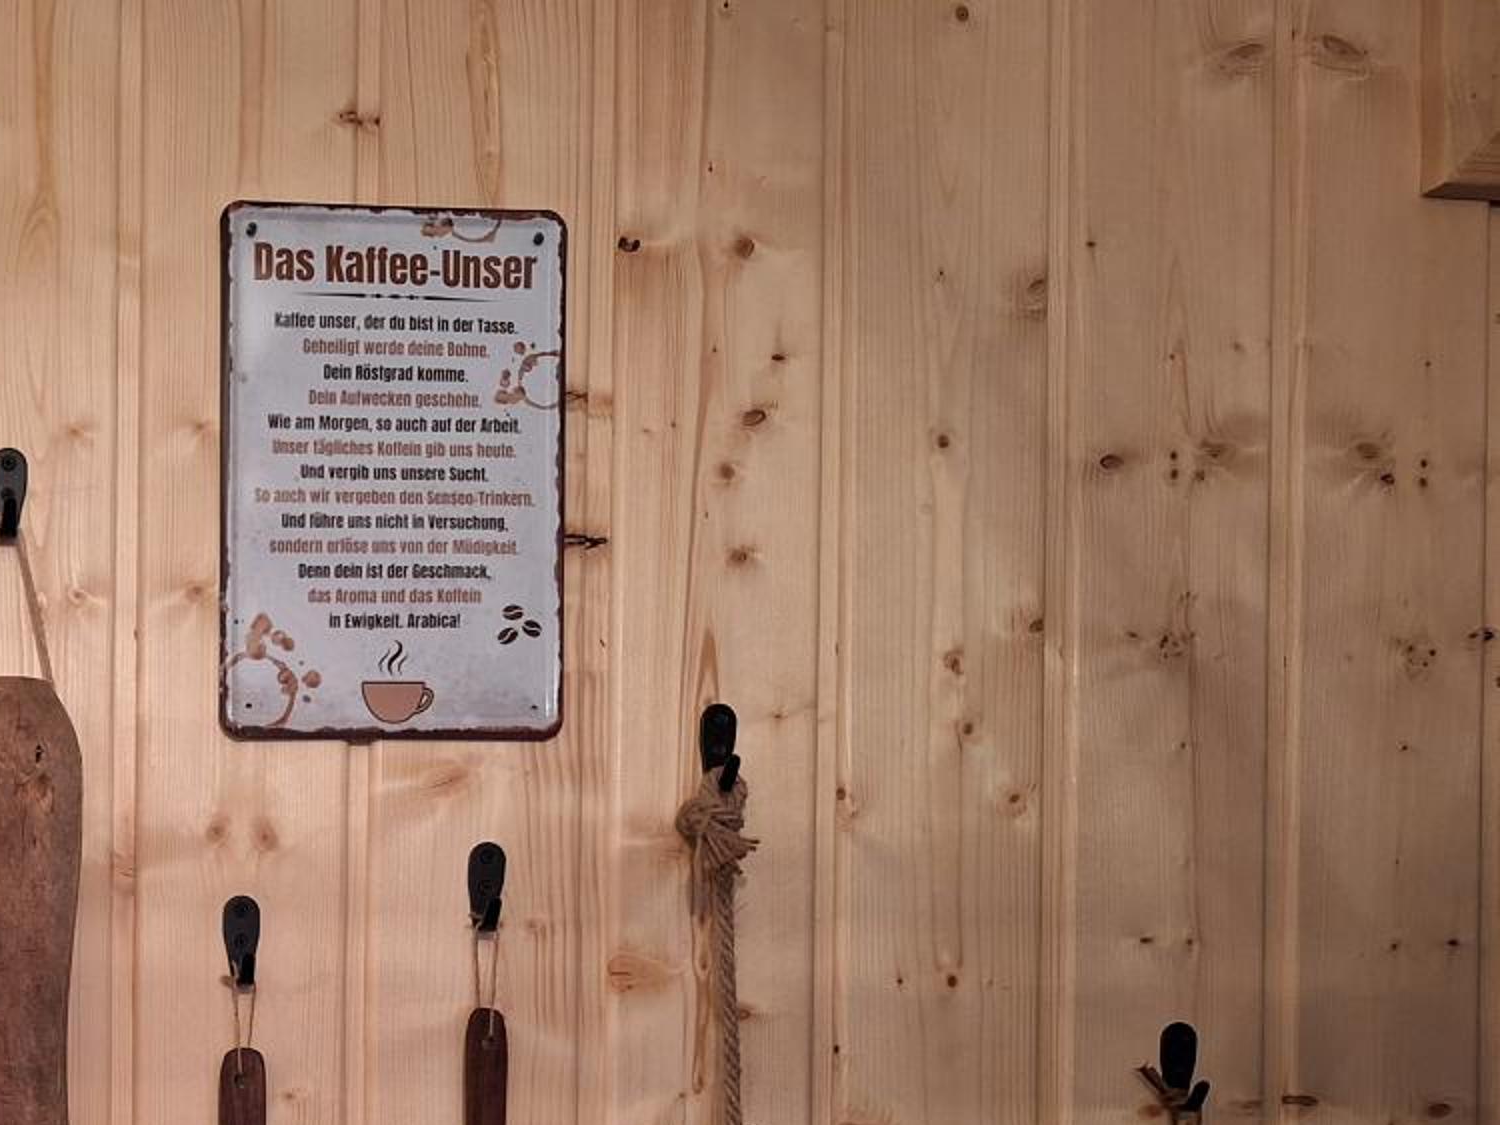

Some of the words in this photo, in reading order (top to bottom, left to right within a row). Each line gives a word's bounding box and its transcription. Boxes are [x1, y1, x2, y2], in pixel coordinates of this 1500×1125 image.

[254, 242, 315, 281] Das
[325, 245, 538, 290] Kaffee-Unser
[274, 312, 316, 329] Kaffee
[319, 314, 361, 331] unser,
[363, 313, 386, 330] der
[389, 315, 405, 331] du
[409, 316, 433, 331] bist
[437, 316, 449, 332] in
[453, 318, 474, 332] der
[478, 318, 519, 335] Tasse.
[303, 338, 360, 356] Geheiligt
[363, 340, 405, 356] werde
[407, 340, 444, 357] deine
[447, 341, 490, 359] Bohne.
[323, 363, 352, 380] Dein
[355, 362, 413, 382] Röstgrad
[417, 366, 469, 383] komme.
[308, 389, 337, 405] Dein
[340, 389, 411, 407] Aufwecken
[415, 391, 482, 409] geschehe.
[267, 413, 291, 429] Wie
[295, 416, 315, 430] am
[319, 415, 373, 432] Morgen,
[375, 418, 393, 431] so
[395, 418, 427, 432] auch
[431, 418, 452, 432] auf
[455, 418, 477, 432] der
[480, 418, 522, 434] Arbeit.
[272, 439, 310, 454] Unser
[313, 438, 373, 456] tägliches
[377, 441, 422, 457] Koffein
[425, 442, 446, 459] gib
[449, 444, 473, 457] uns
[477, 443, 517, 459] heute.
[300, 464, 325, 479] Und
[328, 464, 370, 480] vergib
[373, 467, 397, 480] uns
[401, 467, 446, 481] unsere
[449, 467, 489, 482] Sucht.
[255, 487, 271, 503] So
[274, 488, 306, 503] auch
[309, 488, 332, 503] wir
[334, 490, 395, 505] vergeben
[399, 490, 423, 505] den
[427, 491, 536, 507] Senseo-Trinkern.
[281, 513, 306, 529] Und
[309, 512, 345, 529] führe
[347, 514, 372, 529] uns
[375, 513, 409, 529] nicht
[412, 514, 425, 529] in
[428, 514, 509, 532] Versuchung,
[269, 537, 323, 554] sondern
[326, 537, 369, 554] erlöse
[372, 541, 397, 553] uns
[400, 541, 423, 554] von
[427, 540, 449, 554] der
[298, 563, 331, 579] Denn
[333, 563, 363, 579] dein
[366, 563, 383, 579] ist
[387, 564, 409, 579] der
[412, 563, 492, 581] Geschmack,
[307, 587, 331, 603] das
[334, 588, 378, 604] Aroma
[381, 589, 406, 604] und
[409, 588, 434, 604] das
[437, 588, 482, 604] Koffein
[329, 613, 341, 628] in
[344, 612, 404, 630] Ewigkeit.
[407, 613, 461, 629] Arabica!
